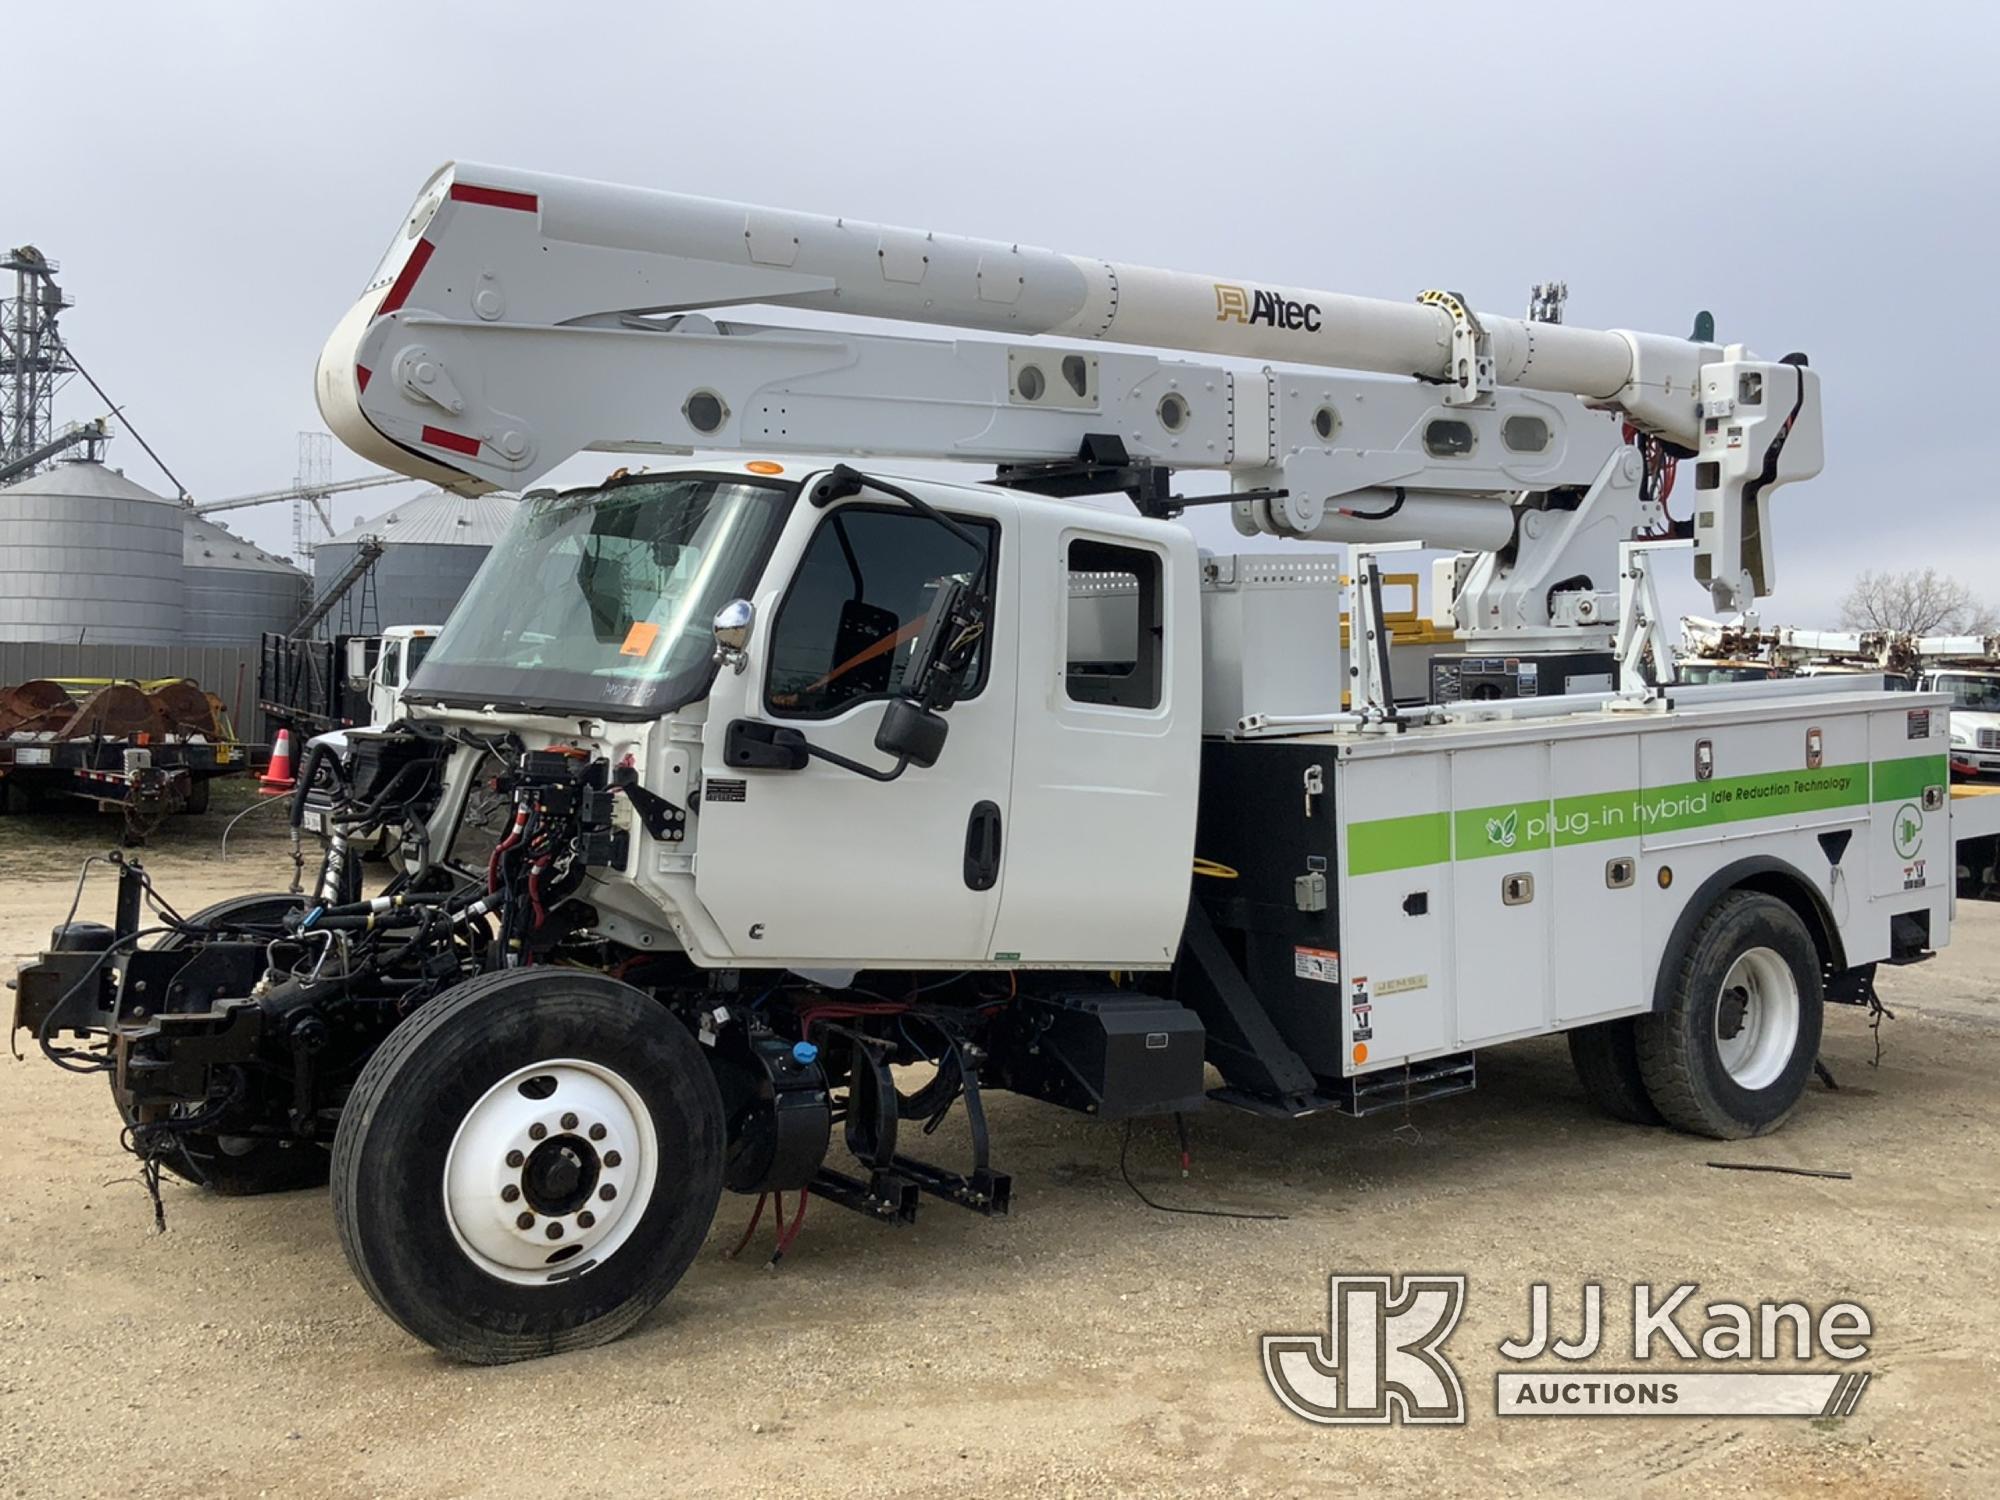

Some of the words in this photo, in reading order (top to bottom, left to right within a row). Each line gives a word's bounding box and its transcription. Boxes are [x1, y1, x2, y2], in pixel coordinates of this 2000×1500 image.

[1248, 289, 1322, 333] Altec
[1711, 790, 1733, 804] Idle
[1735, 783, 1790, 801] Reduction
[1794, 777, 1852, 792] Technology
[1527, 804, 1624, 841] plug-in
[1632, 793, 1707, 824] hybrid
